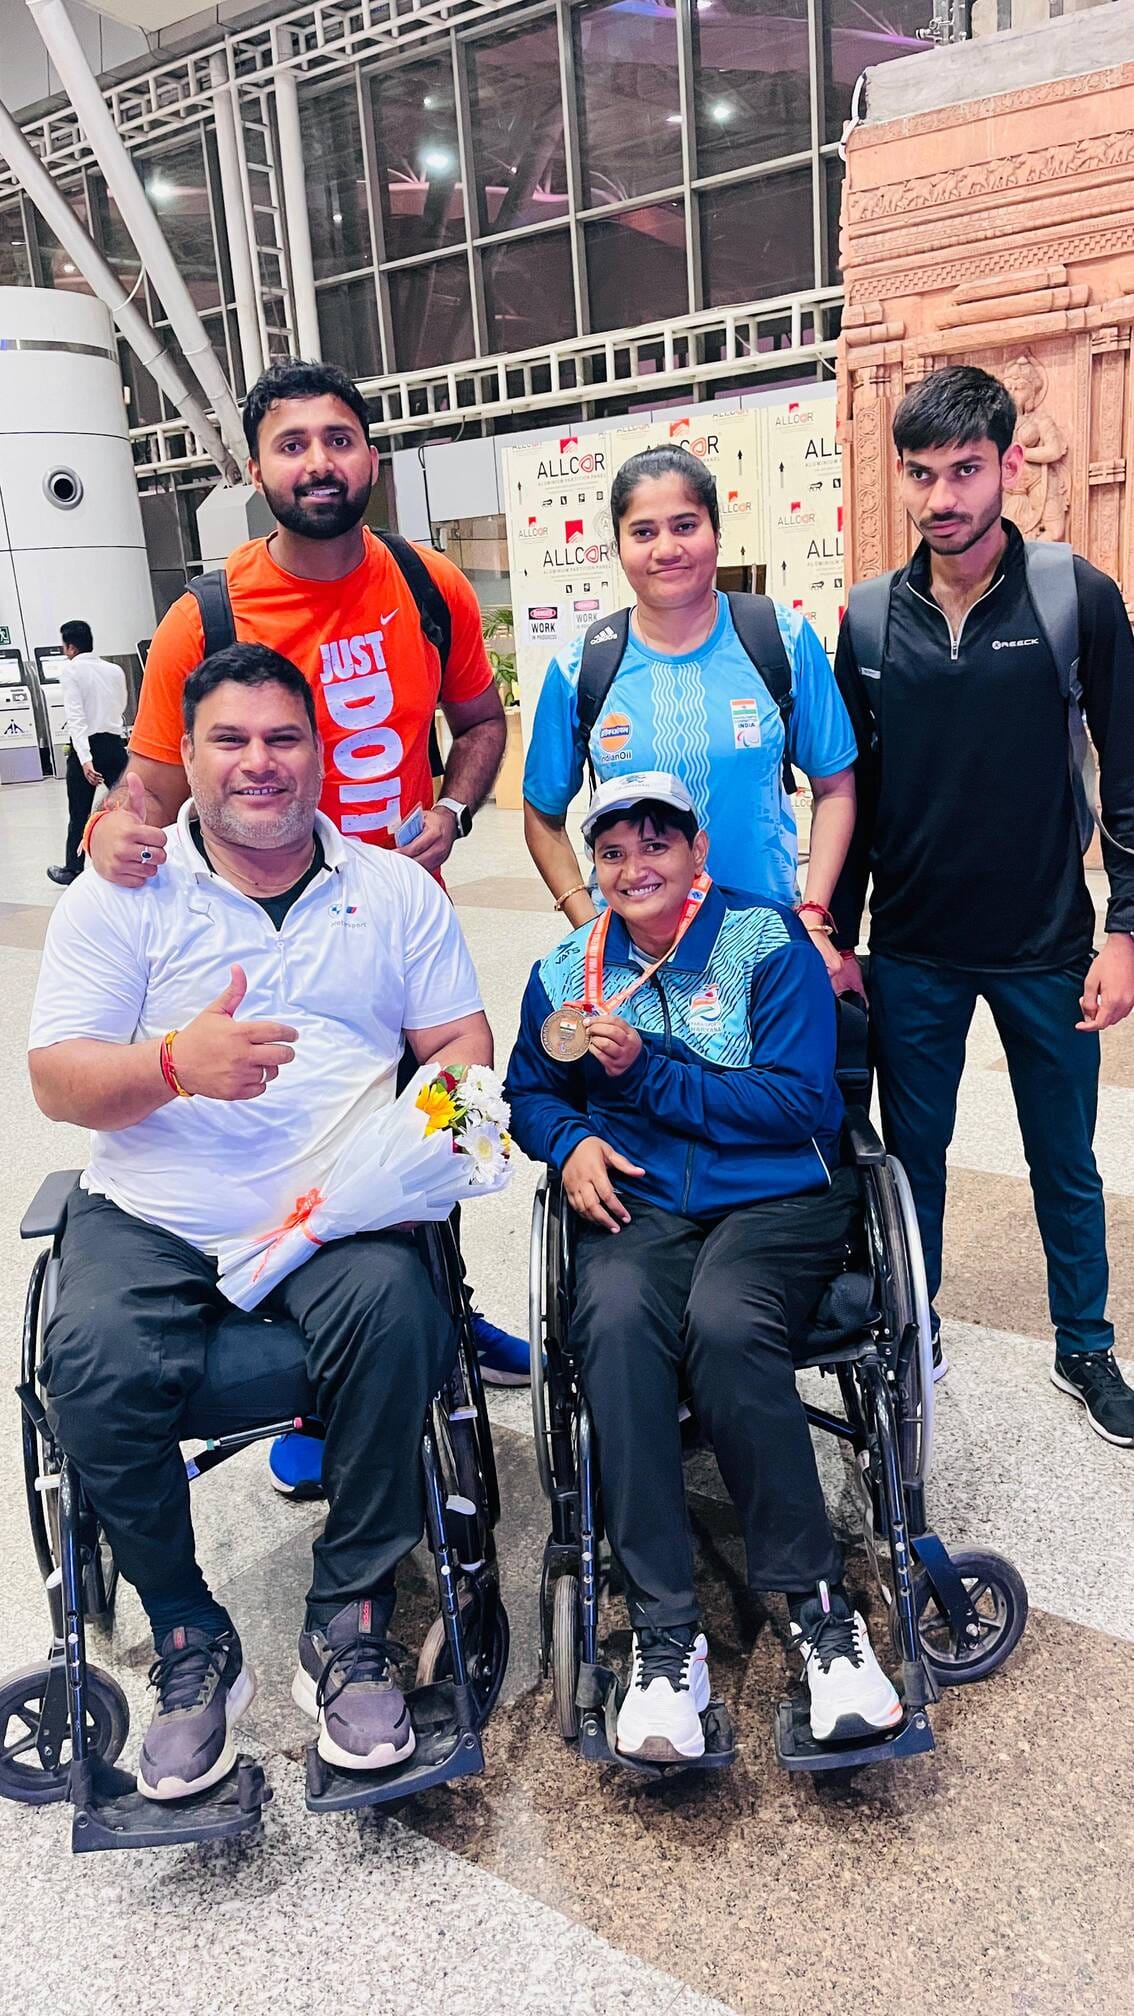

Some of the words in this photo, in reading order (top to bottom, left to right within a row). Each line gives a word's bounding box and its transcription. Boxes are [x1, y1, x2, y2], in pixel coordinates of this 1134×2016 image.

[776, 412, 814, 426] ALLCOR
[537, 452, 605, 480] ALLCOR
[777, 513, 815, 526] ALLCOR
[519, 526, 548, 539] ALLCOR
[543, 543, 609, 568] ALLCOR
[531, 622, 556, 633] WORK
[320, 630, 387, 684] JUST
[555, 947, 582, 965] VATS
